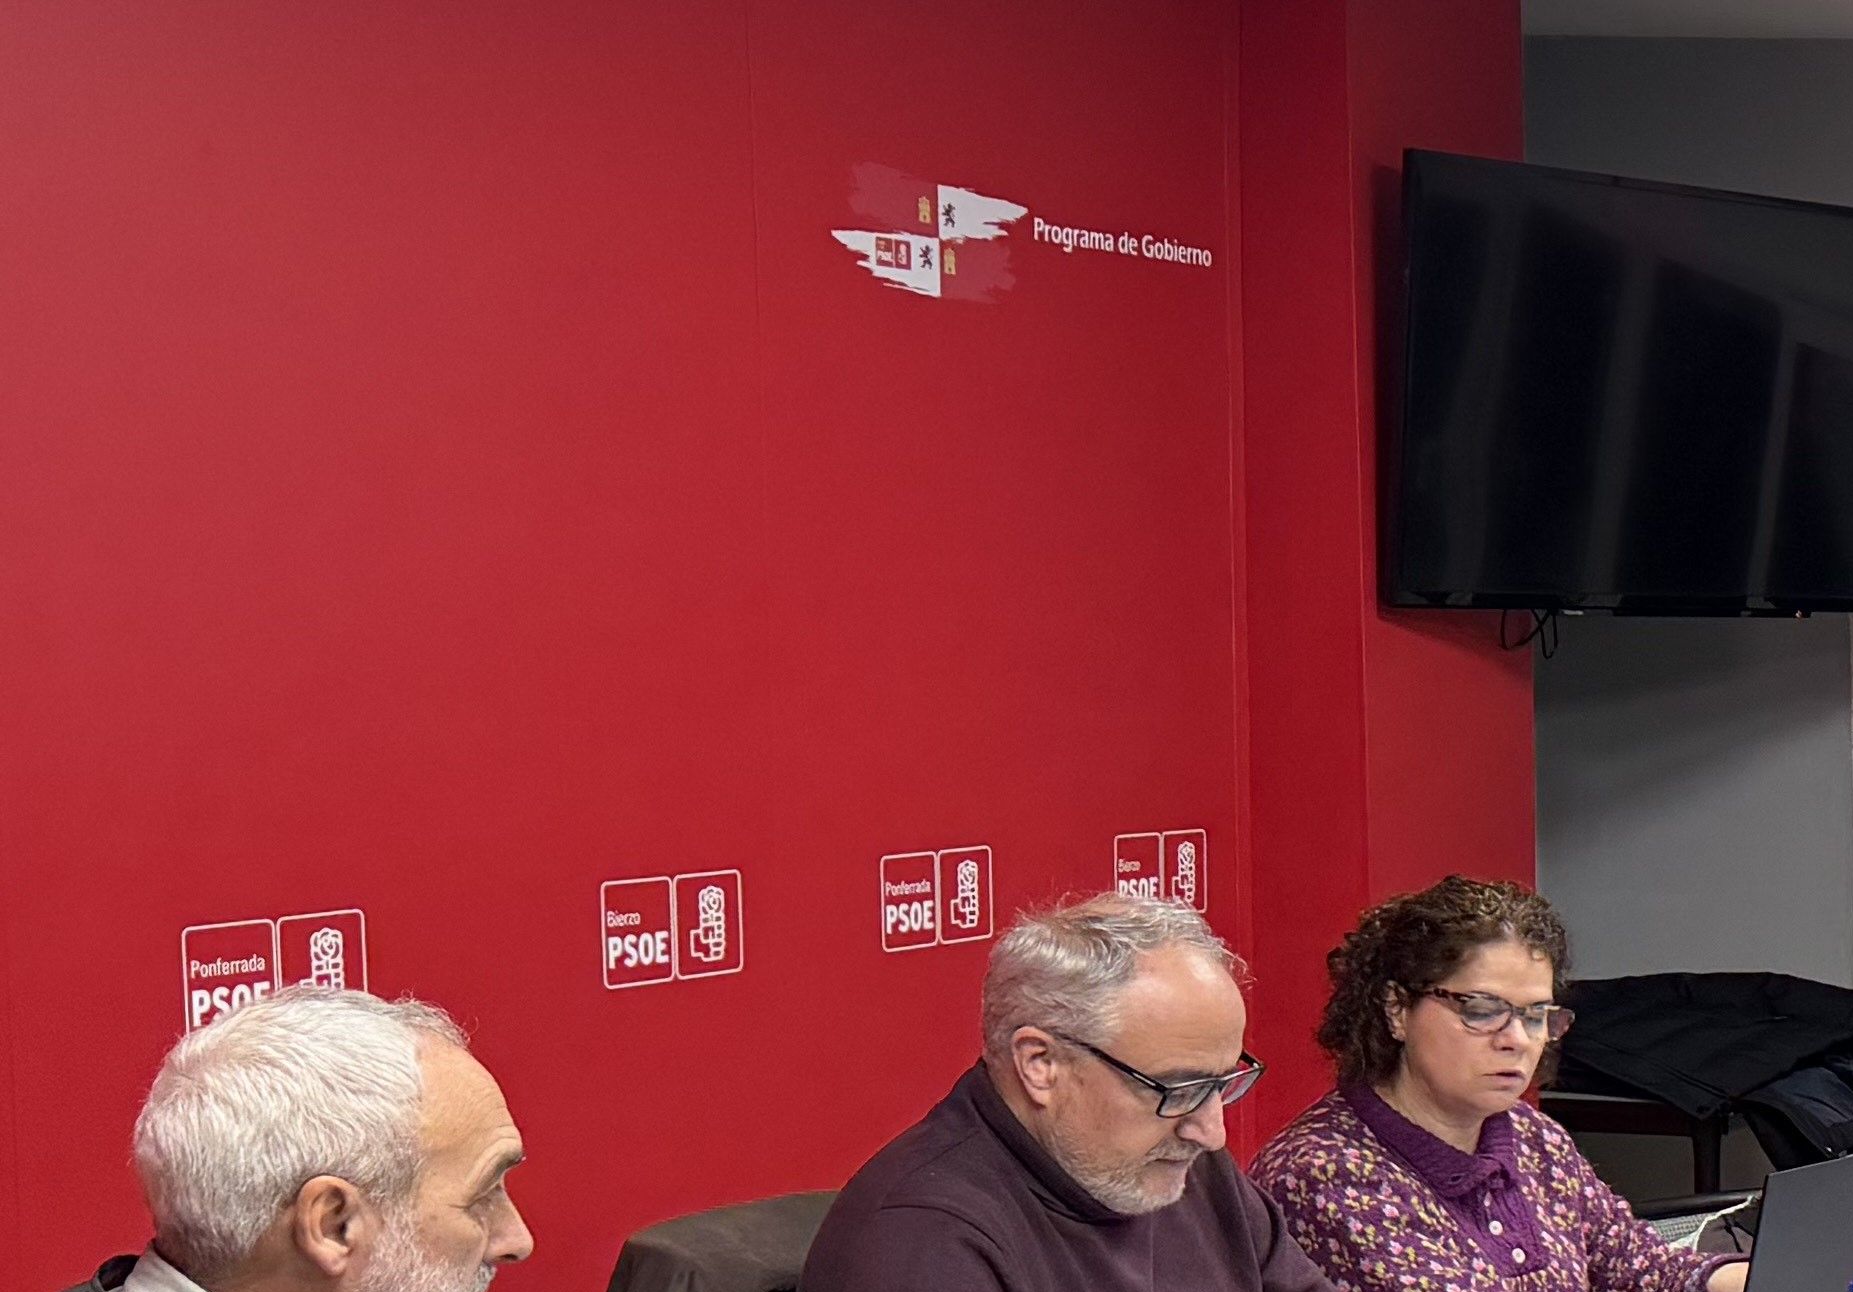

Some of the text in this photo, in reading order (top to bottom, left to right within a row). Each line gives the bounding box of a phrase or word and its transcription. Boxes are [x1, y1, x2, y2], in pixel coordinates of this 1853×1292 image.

[1033, 217, 1212, 267] Programa de Gobierno
[886, 900, 934, 935] PSOE
[190, 954, 265, 978] Ponferrada
[607, 931, 669, 970] PSOE
